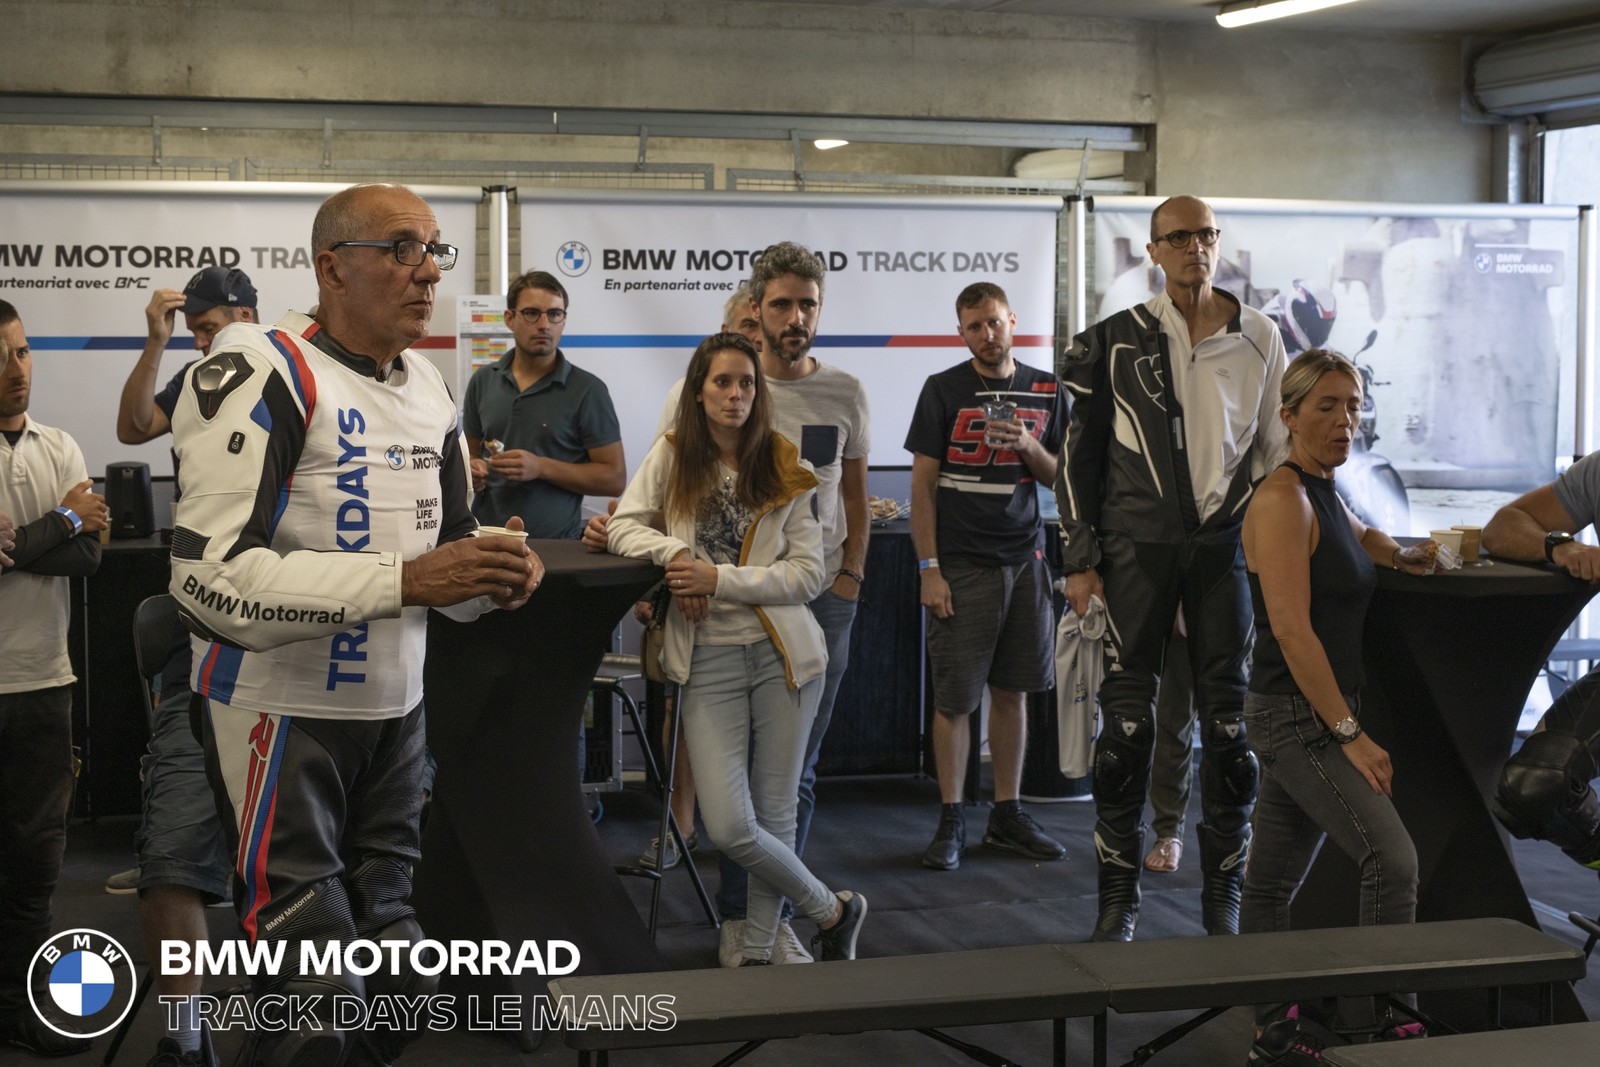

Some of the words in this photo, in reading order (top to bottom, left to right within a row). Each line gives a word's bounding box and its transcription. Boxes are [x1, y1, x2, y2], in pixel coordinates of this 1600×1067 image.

[55, 245, 240, 269] MOTORRAD
[251, 247, 311, 269] TRA
[603, 249, 676, 270] BMW
[857, 251, 946, 272] TRACK
[952, 252, 1020, 273] DAYS
[1496, 253, 1523, 263] BMW
[1496, 264, 1553, 274] MOTORRAD
[75, 279, 110, 289] avec
[114, 277, 150, 289] BMC
[604, 279, 621, 290] En
[624, 279, 702, 293] partenariat
[703, 281, 733, 291] avec
[416, 498, 438, 508] MAKE
[416, 509, 432, 519] LIFE
[416, 521, 422, 531] A
[423, 519, 438, 530] RIDE
[182, 574, 240, 615] BMW
[240, 600, 345, 625] Motorrad
[265, 913, 285, 931] BMW
[284, 889, 315, 917] Motorrad
